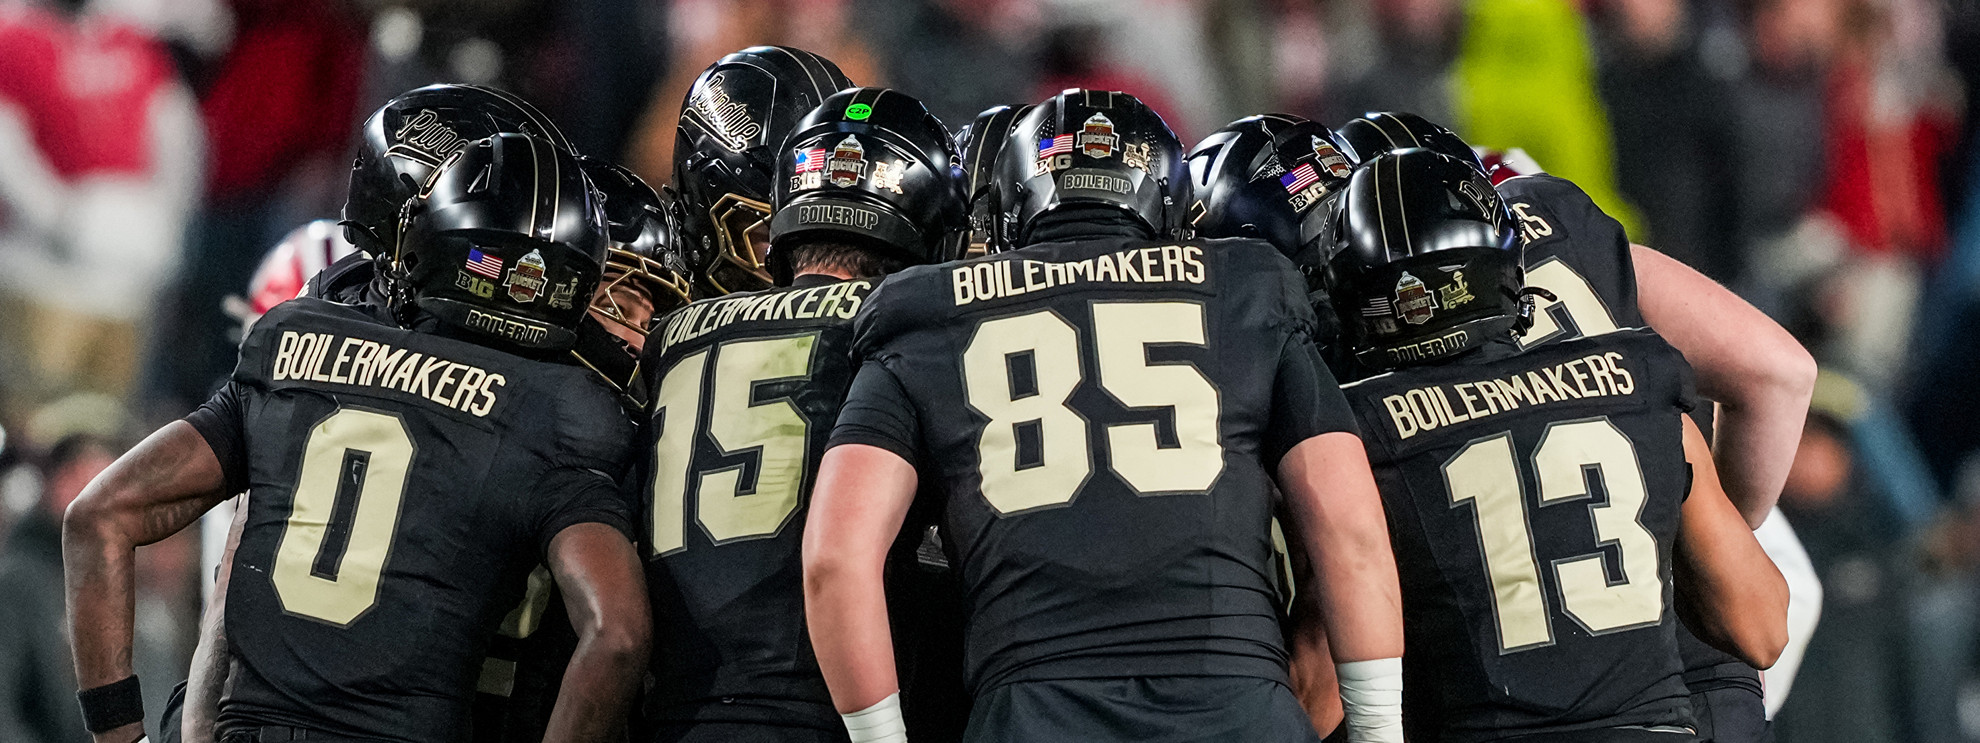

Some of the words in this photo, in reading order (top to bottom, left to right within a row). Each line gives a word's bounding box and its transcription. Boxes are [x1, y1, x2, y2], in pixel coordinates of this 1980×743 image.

[847, 106, 870, 115] C2P
[799, 205, 853, 226] BOILER
[855, 208, 878, 230] UP
[1064, 174, 1112, 191] BOILER
[1113, 178, 1132, 194] UP
[952, 245, 1205, 306] BOILERMAKERS
[465, 309, 526, 340] BOILER
[524, 325, 548, 344] UP
[660, 280, 872, 357] BOILERMAKERS
[1443, 330, 1468, 350] UP
[273, 331, 506, 417] BOILERMAKERS
[960, 300, 1228, 519] 85
[1383, 352, 1635, 440] BOILERMAKERS
[650, 331, 822, 561] 15
[270, 404, 418, 629] 0
[1440, 415, 1664, 655] 13
